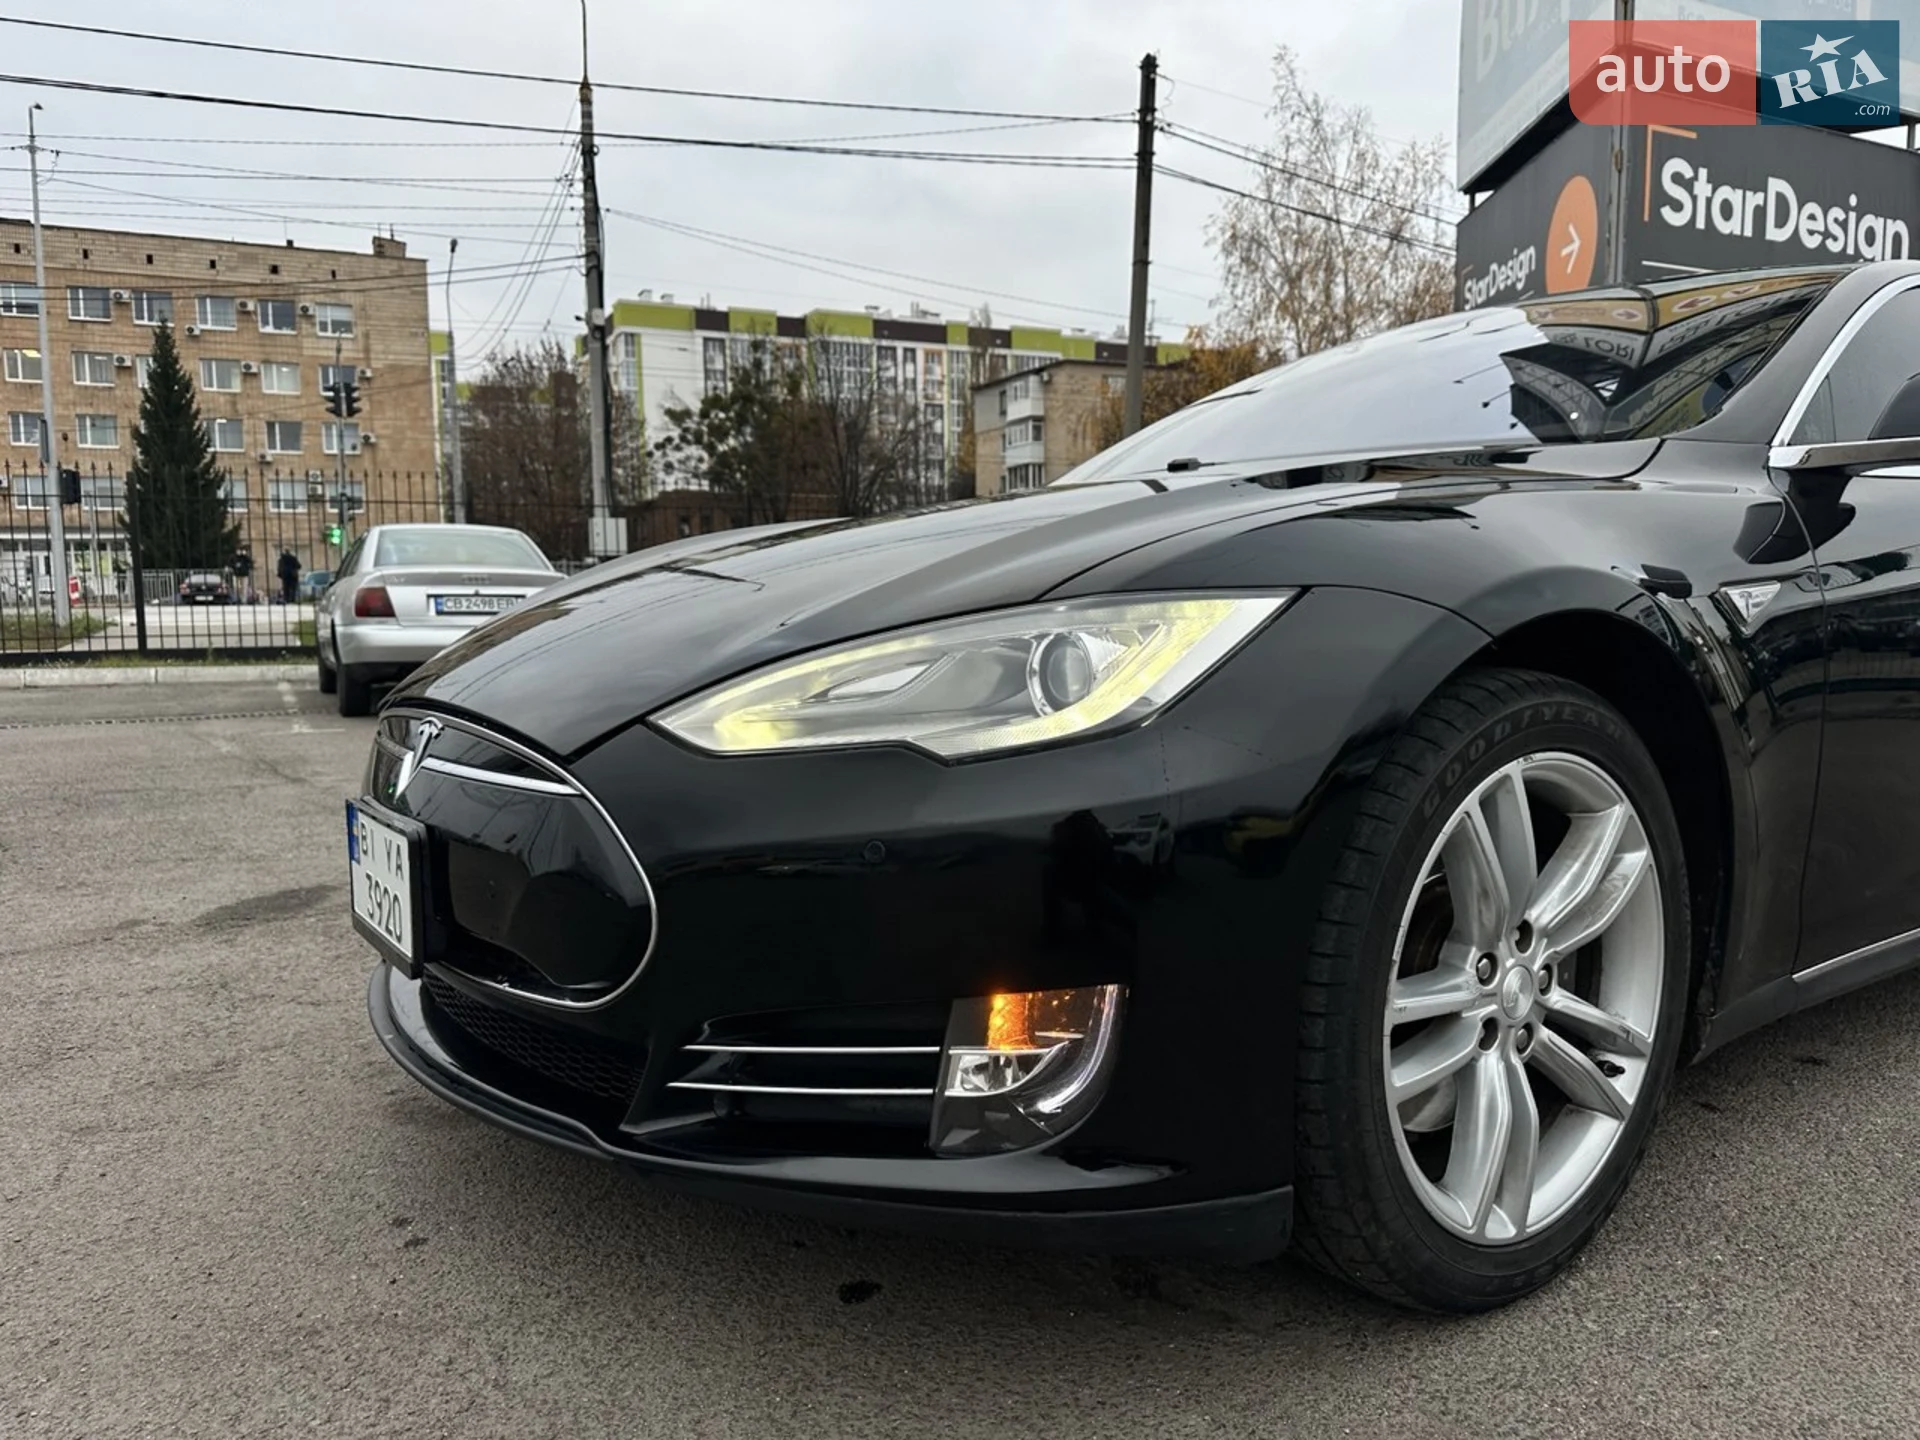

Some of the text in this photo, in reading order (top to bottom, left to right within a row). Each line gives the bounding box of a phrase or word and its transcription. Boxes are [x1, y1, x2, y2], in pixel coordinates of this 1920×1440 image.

[1659, 157, 1910, 261] StarDesign
[1464, 245, 1536, 311] StarDesign
[465, 598, 495, 610] 2498
[1424, 704, 1626, 817] GOODYEAR
[365, 871, 403, 944] 3920
